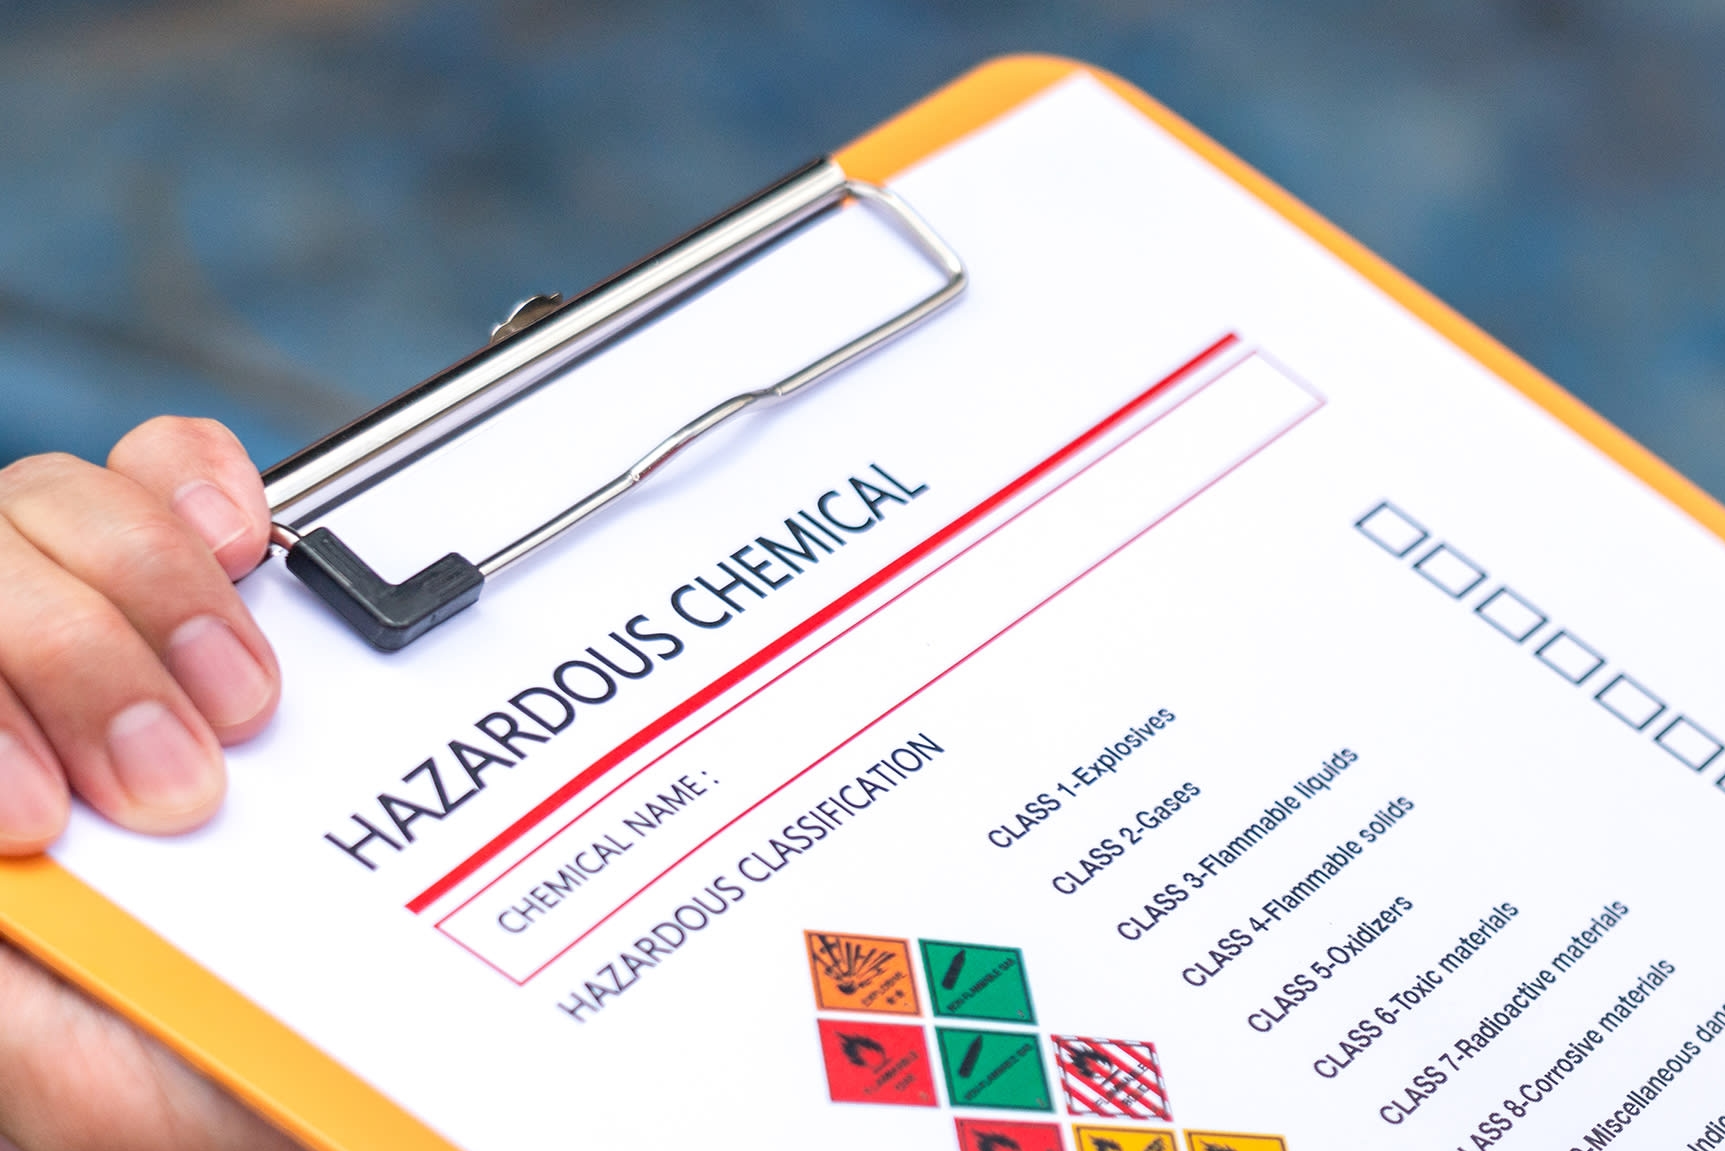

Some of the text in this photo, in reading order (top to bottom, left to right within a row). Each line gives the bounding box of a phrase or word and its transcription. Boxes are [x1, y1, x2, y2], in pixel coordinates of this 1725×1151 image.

[323, 463, 929, 871] HAZARDOUS CHEMICAL
[497, 834, 634, 934] CHEMICAL
[622, 775, 707, 837] NAME
[988, 708, 1176, 848] CLASS 1-Explosives
[1052, 782, 1201, 895] CLASS 2-Gases
[1117, 748, 1359, 941] CLASS 3-Flammable liquids
[557, 732, 945, 1022] HAZARDOUS CLASSIFICATION
[1182, 796, 1415, 987] CLASS 4-Flammable solids
[1247, 896, 1413, 1033] CLASS 5-Oxidizers
[1313, 902, 1519, 1079] CLASS 6-Toxic materials
[1379, 901, 1629, 1125] CLASS 7-Radioactive materials
[1503, 1029, 1604, 1118] 8-Corrosive
[1598, 960, 1676, 1033] materials
